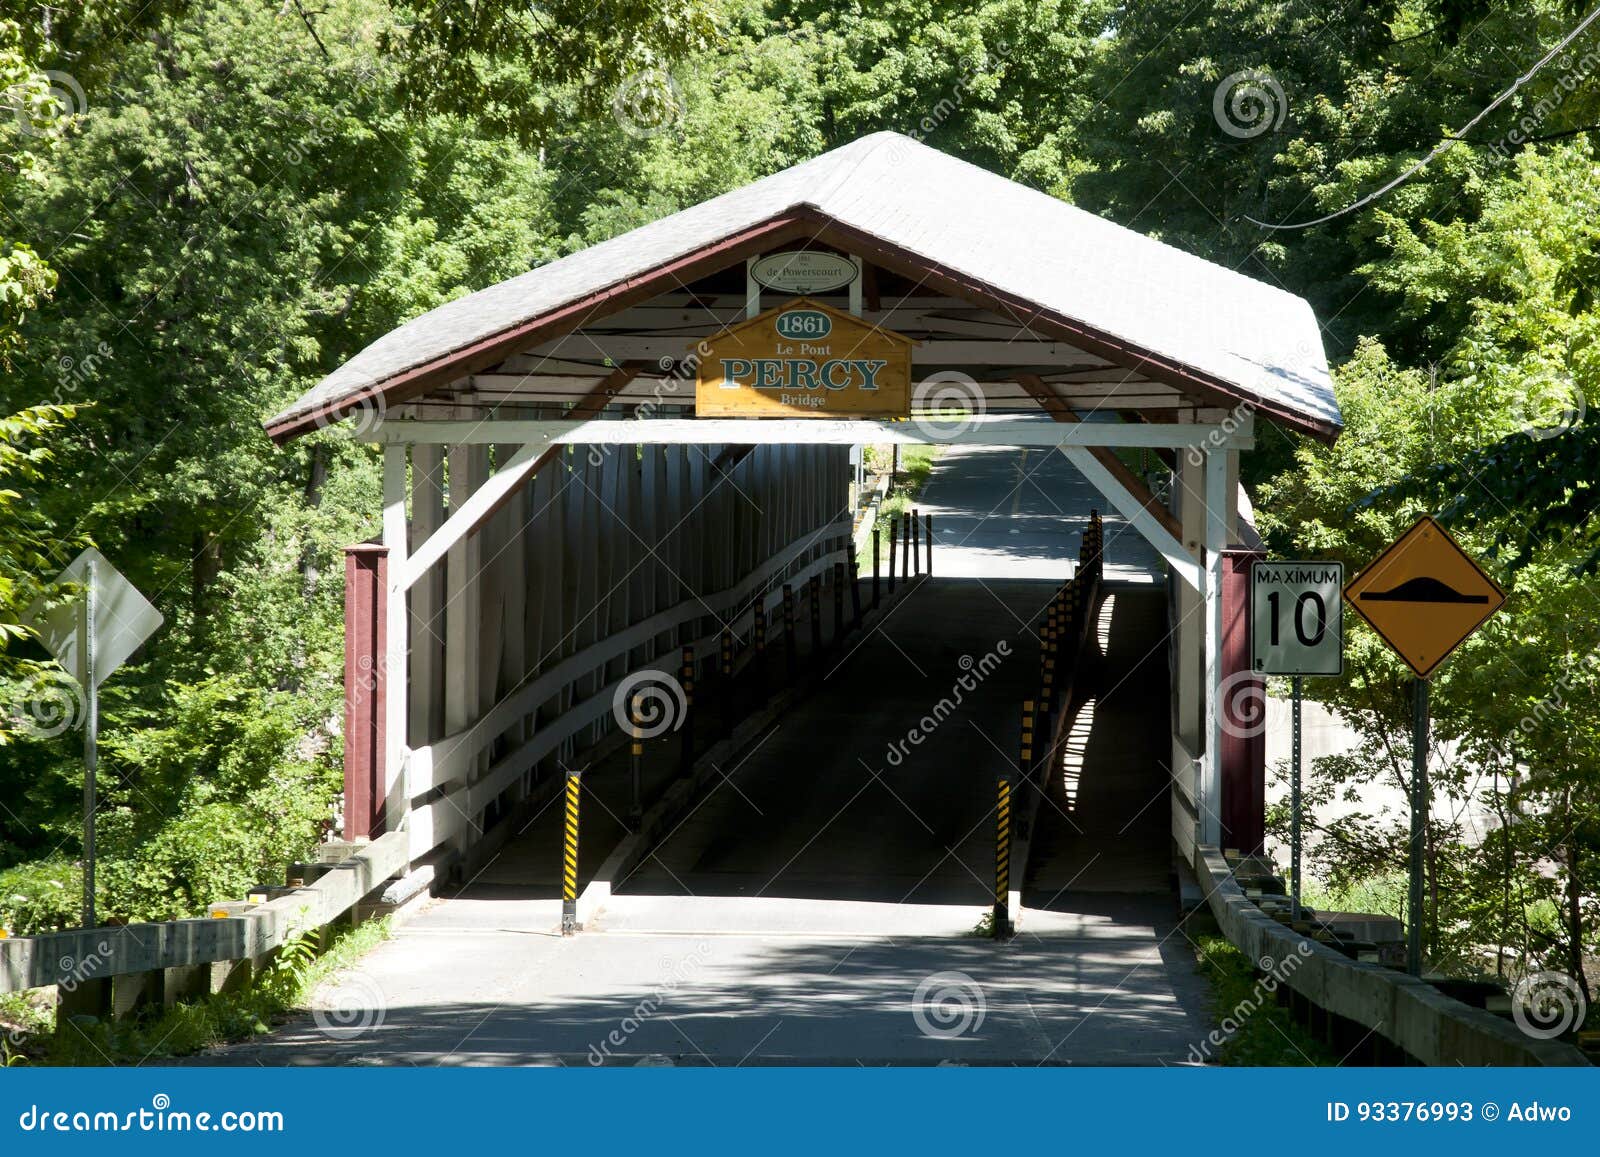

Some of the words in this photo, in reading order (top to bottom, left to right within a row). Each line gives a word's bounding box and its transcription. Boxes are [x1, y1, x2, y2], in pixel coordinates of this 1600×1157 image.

[782, 267, 842, 277] Powerscourt
[781, 316, 826, 333] 1861
[776, 343, 793, 355] Le
[800, 343, 832, 355] Pont
[718, 358, 888, 391] PERCY
[780, 393, 826, 407] Bridge
[1257, 570, 1338, 584] MAXIMUM
[1267, 590, 1326, 647] 10
